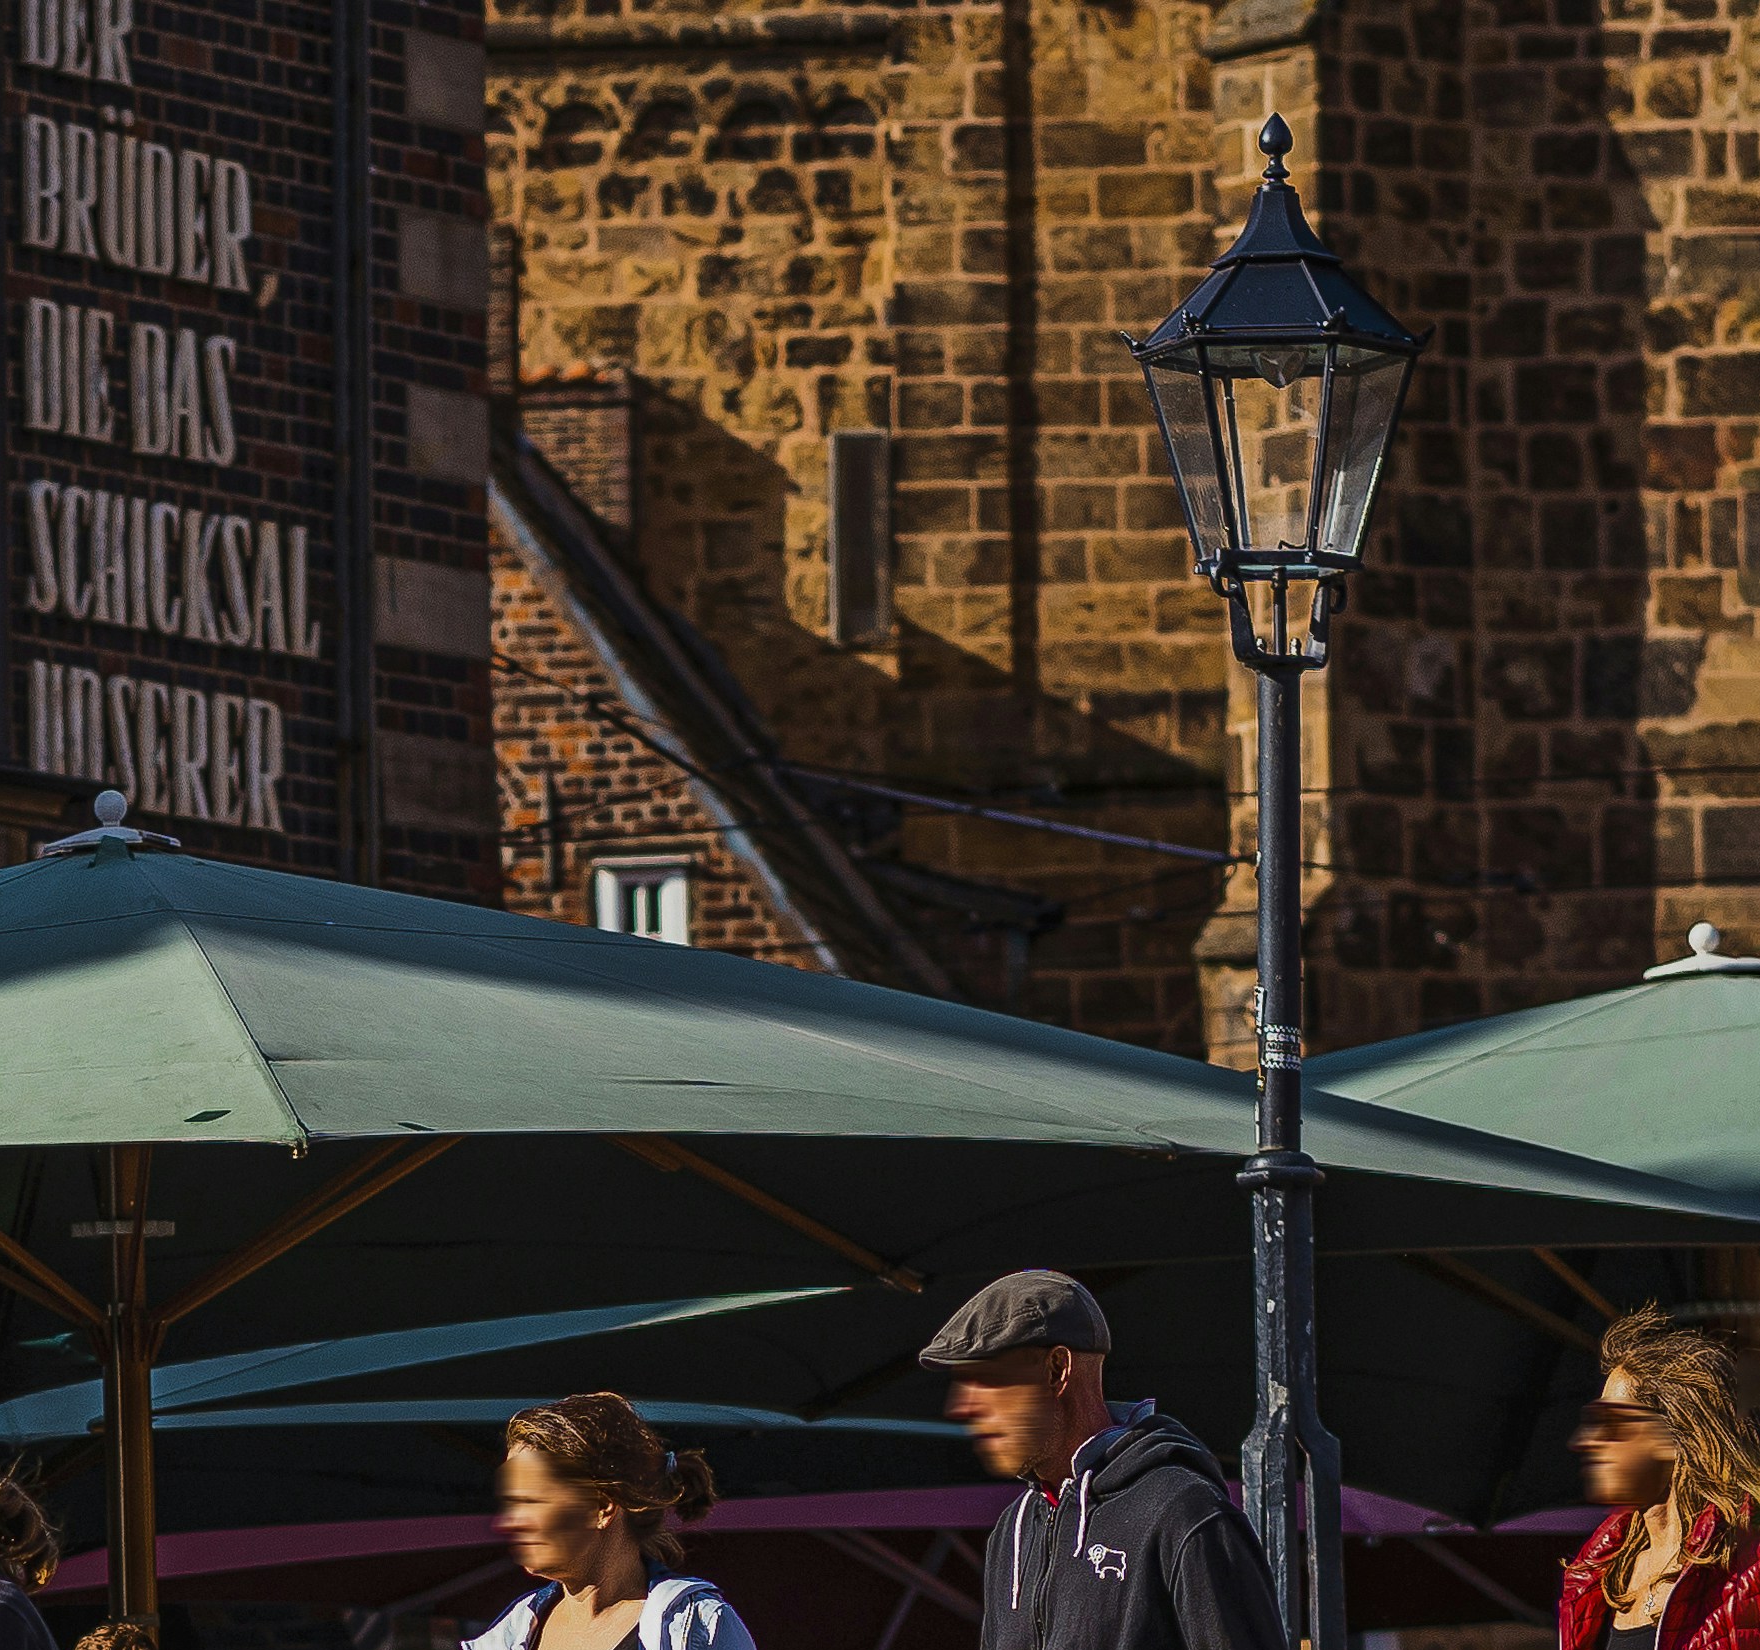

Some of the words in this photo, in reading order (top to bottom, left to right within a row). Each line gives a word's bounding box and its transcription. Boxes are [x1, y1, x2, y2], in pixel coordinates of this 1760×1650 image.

[21, 103, 279, 310] BRÜDER,
[24, 296, 116, 445] DIE
[129, 321, 238, 468] DAS
[27, 478, 322, 660] SCHICKSAL
